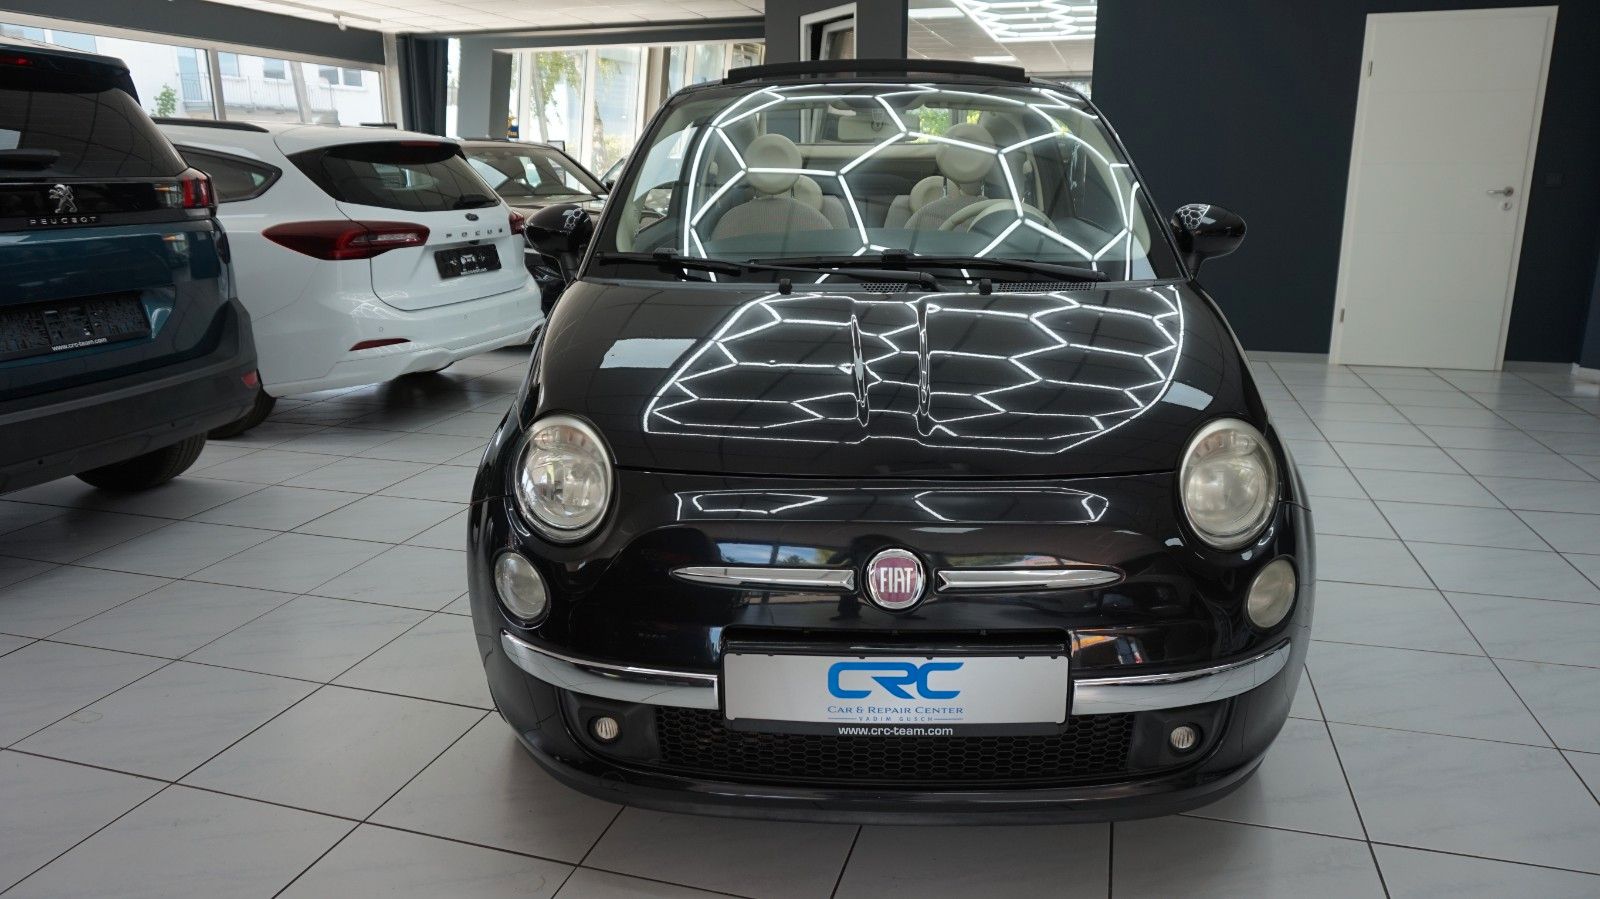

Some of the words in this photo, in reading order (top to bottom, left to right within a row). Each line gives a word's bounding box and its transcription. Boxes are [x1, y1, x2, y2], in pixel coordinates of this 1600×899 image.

[30, 216, 96, 225] PEUGEOT
[880, 567, 914, 593] FIAT
[828, 662, 964, 699] CRC
[856, 706, 863, 714] &
[838, 727, 953, 736] www.crc-team.com
